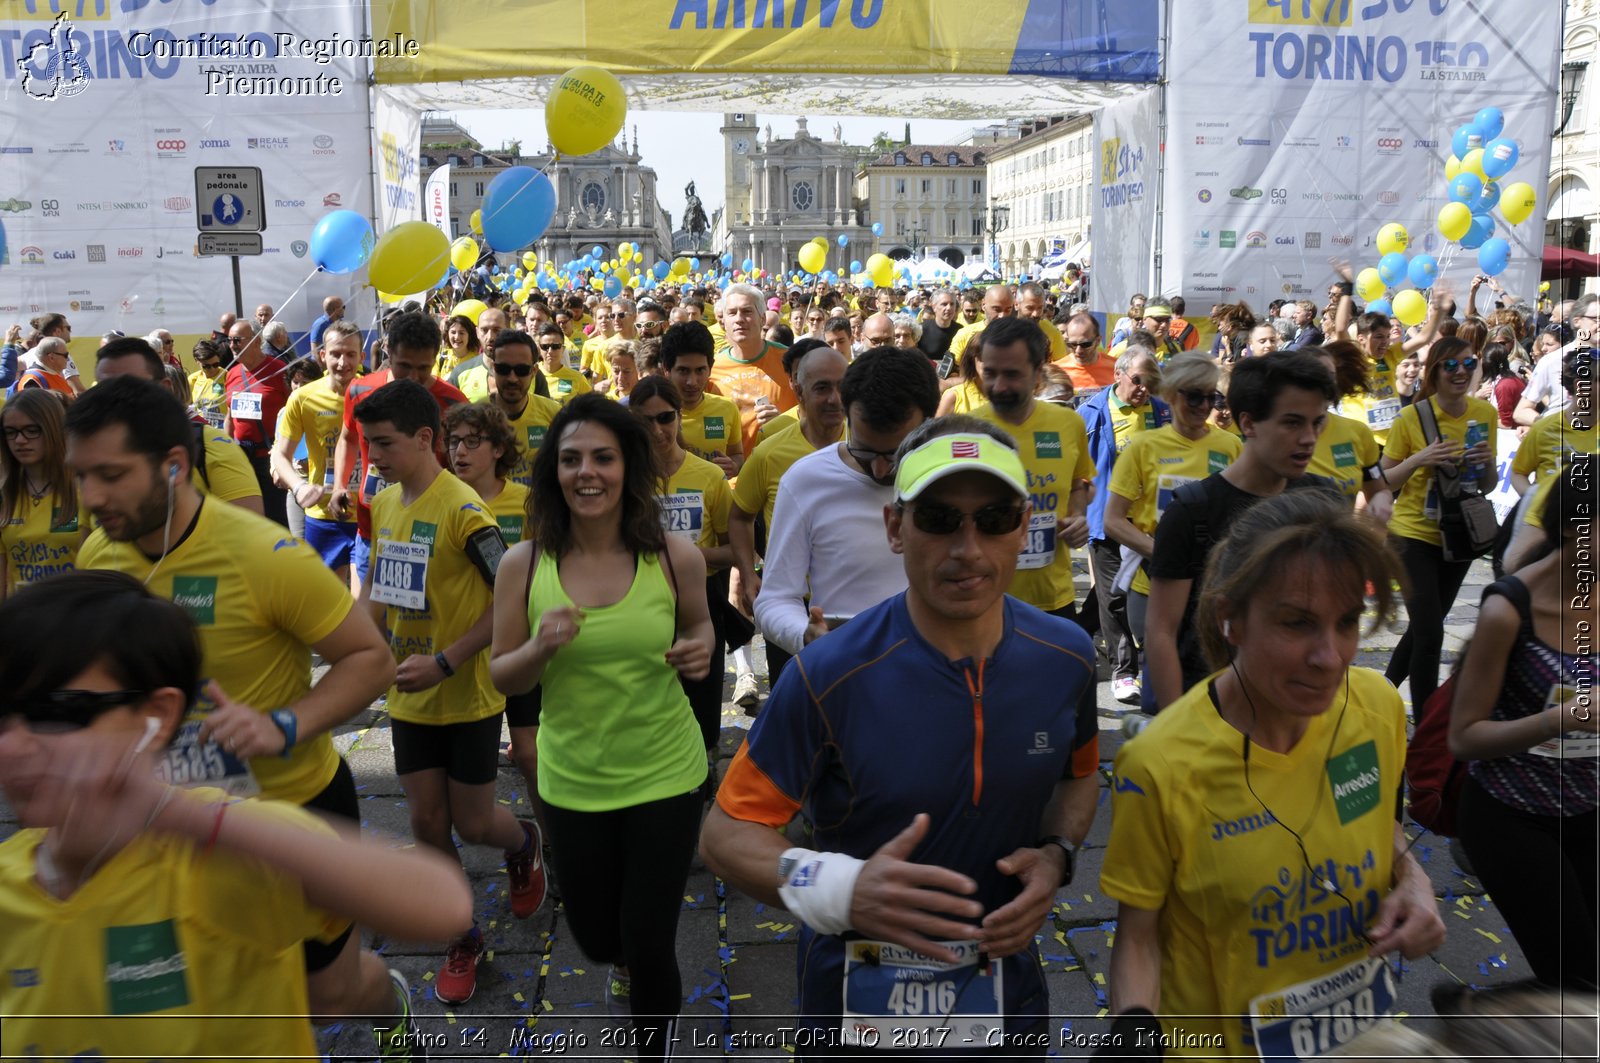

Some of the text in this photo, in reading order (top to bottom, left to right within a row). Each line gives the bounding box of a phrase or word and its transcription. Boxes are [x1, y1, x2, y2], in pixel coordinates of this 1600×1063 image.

[1248, 31, 1489, 83] TORINO 150
[1420, 70, 1487, 82] LA STAMPA
[157, 139, 186, 151] coop
[1377, 138, 1403, 151] coop
[207, 181, 248, 189] pedonale
[1101, 183, 1127, 208] TORINO
[1271, 188, 1287, 199] GO
[41, 199, 59, 210] GO
[1275, 236, 1295, 245] Cuki
[1331, 234, 1354, 246] inalpi
[53, 250, 76, 260] Cuki
[118, 247, 143, 257] inalpi
[411, 532, 434, 545] Arredo3
[379, 558, 412, 590] 8488
[1334, 766, 1380, 800] Arredo3
[1211, 809, 1277, 841] Joma
[894, 968, 935, 981] ANTONIO
[886, 980, 956, 1016] 4916
